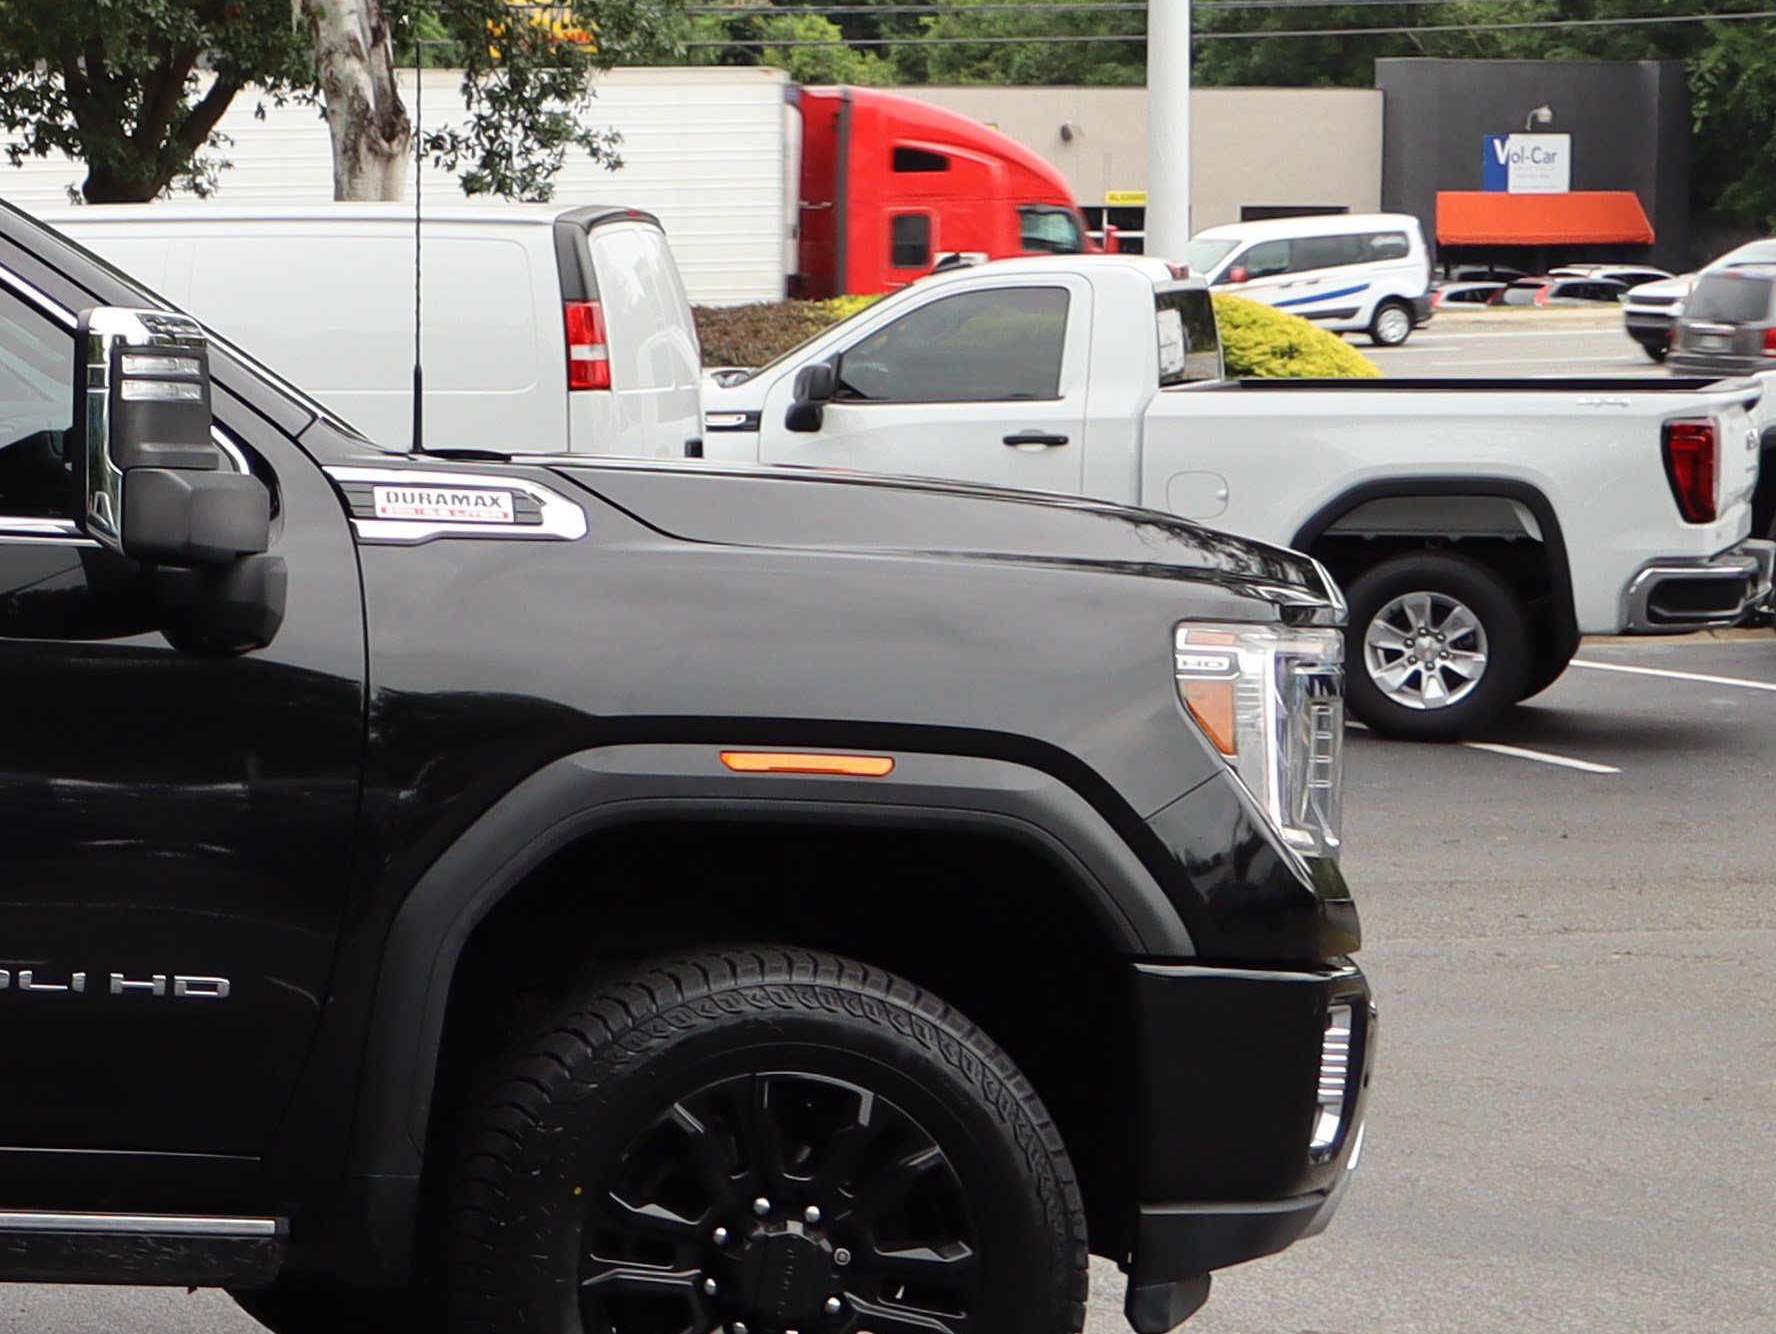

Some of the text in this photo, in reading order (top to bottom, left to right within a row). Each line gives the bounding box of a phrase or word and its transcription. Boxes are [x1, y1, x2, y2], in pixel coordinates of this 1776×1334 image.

[1493, 138, 1557, 165] Vol-Car
[386, 491, 502, 508] DURAMAX
[109, 972, 231, 999] HD
